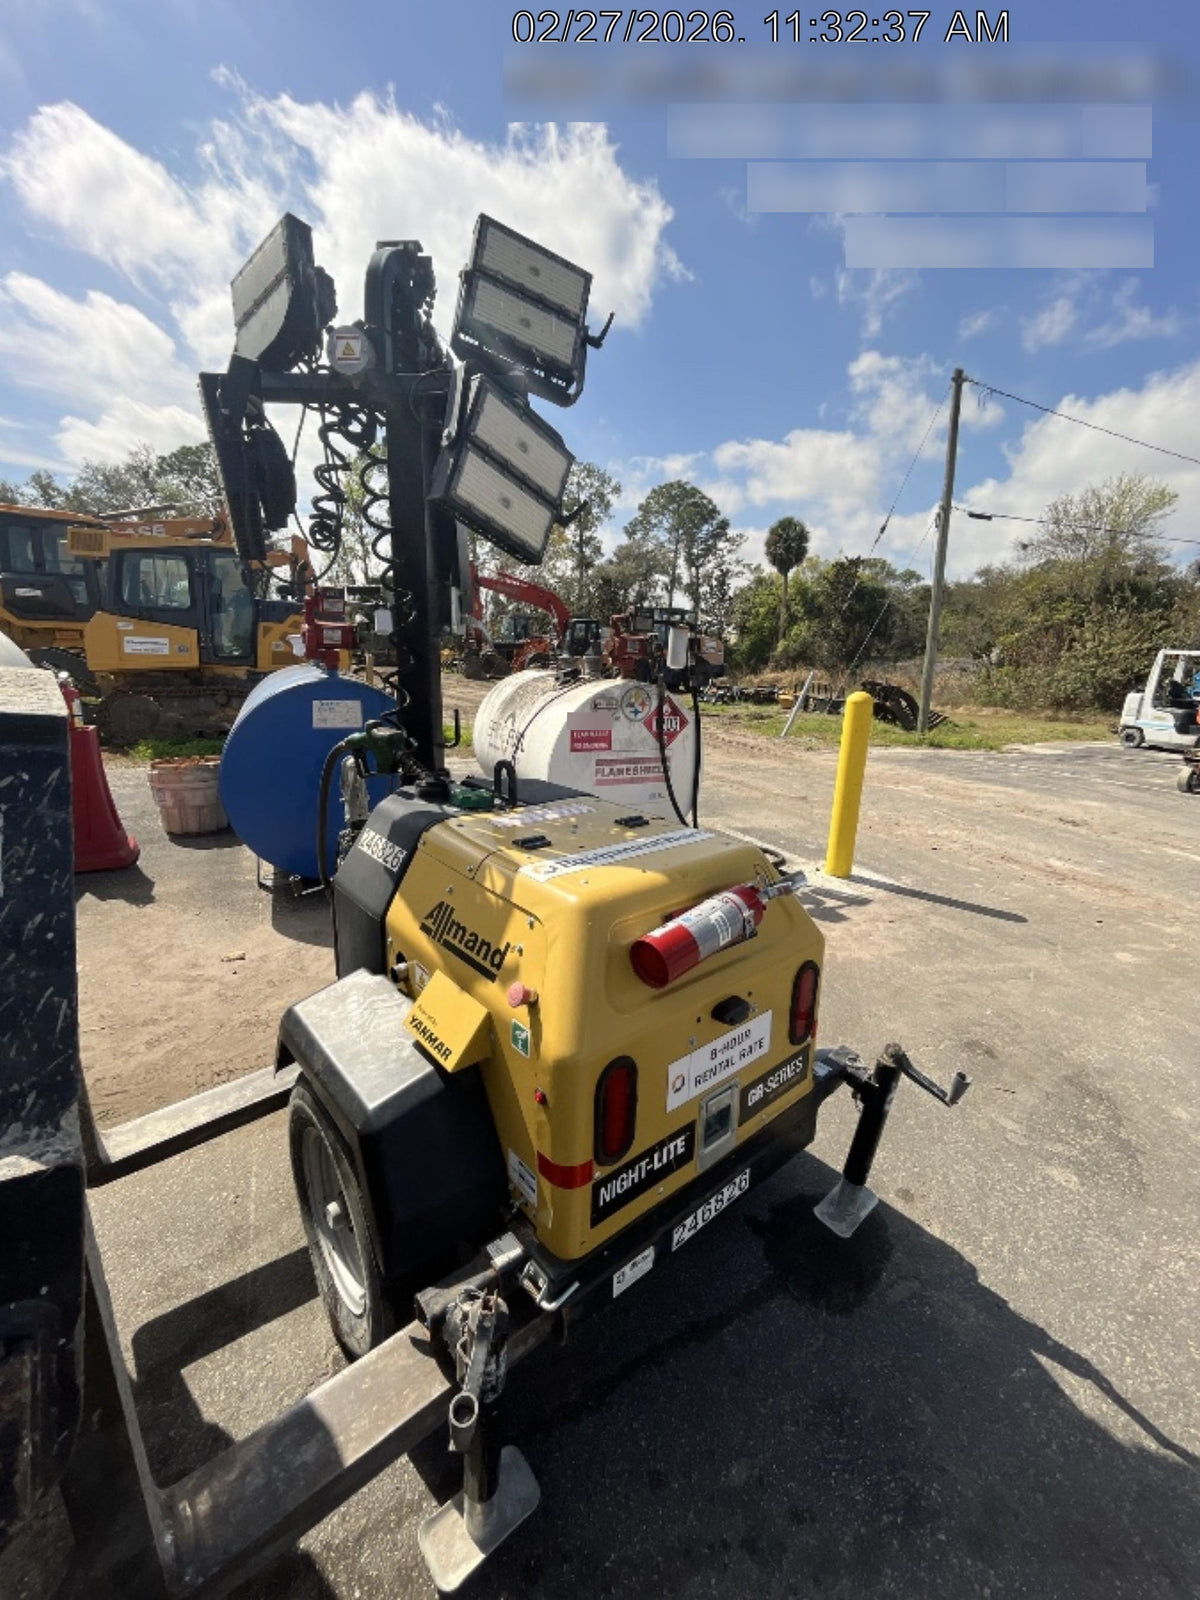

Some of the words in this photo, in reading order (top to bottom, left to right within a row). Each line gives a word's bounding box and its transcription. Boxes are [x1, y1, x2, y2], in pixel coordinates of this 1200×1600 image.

[595, 765, 672, 778] FLAMESHIEL
[423, 900, 511, 973] Allmand
[409, 1013, 453, 1062] YANMAR
[694, 1056, 736, 1088] RENTAL
[738, 1036, 765, 1061] RATE
[747, 1055, 803, 1106] GR-SERIES
[599, 1134, 687, 1207] NIGHT-LITE
